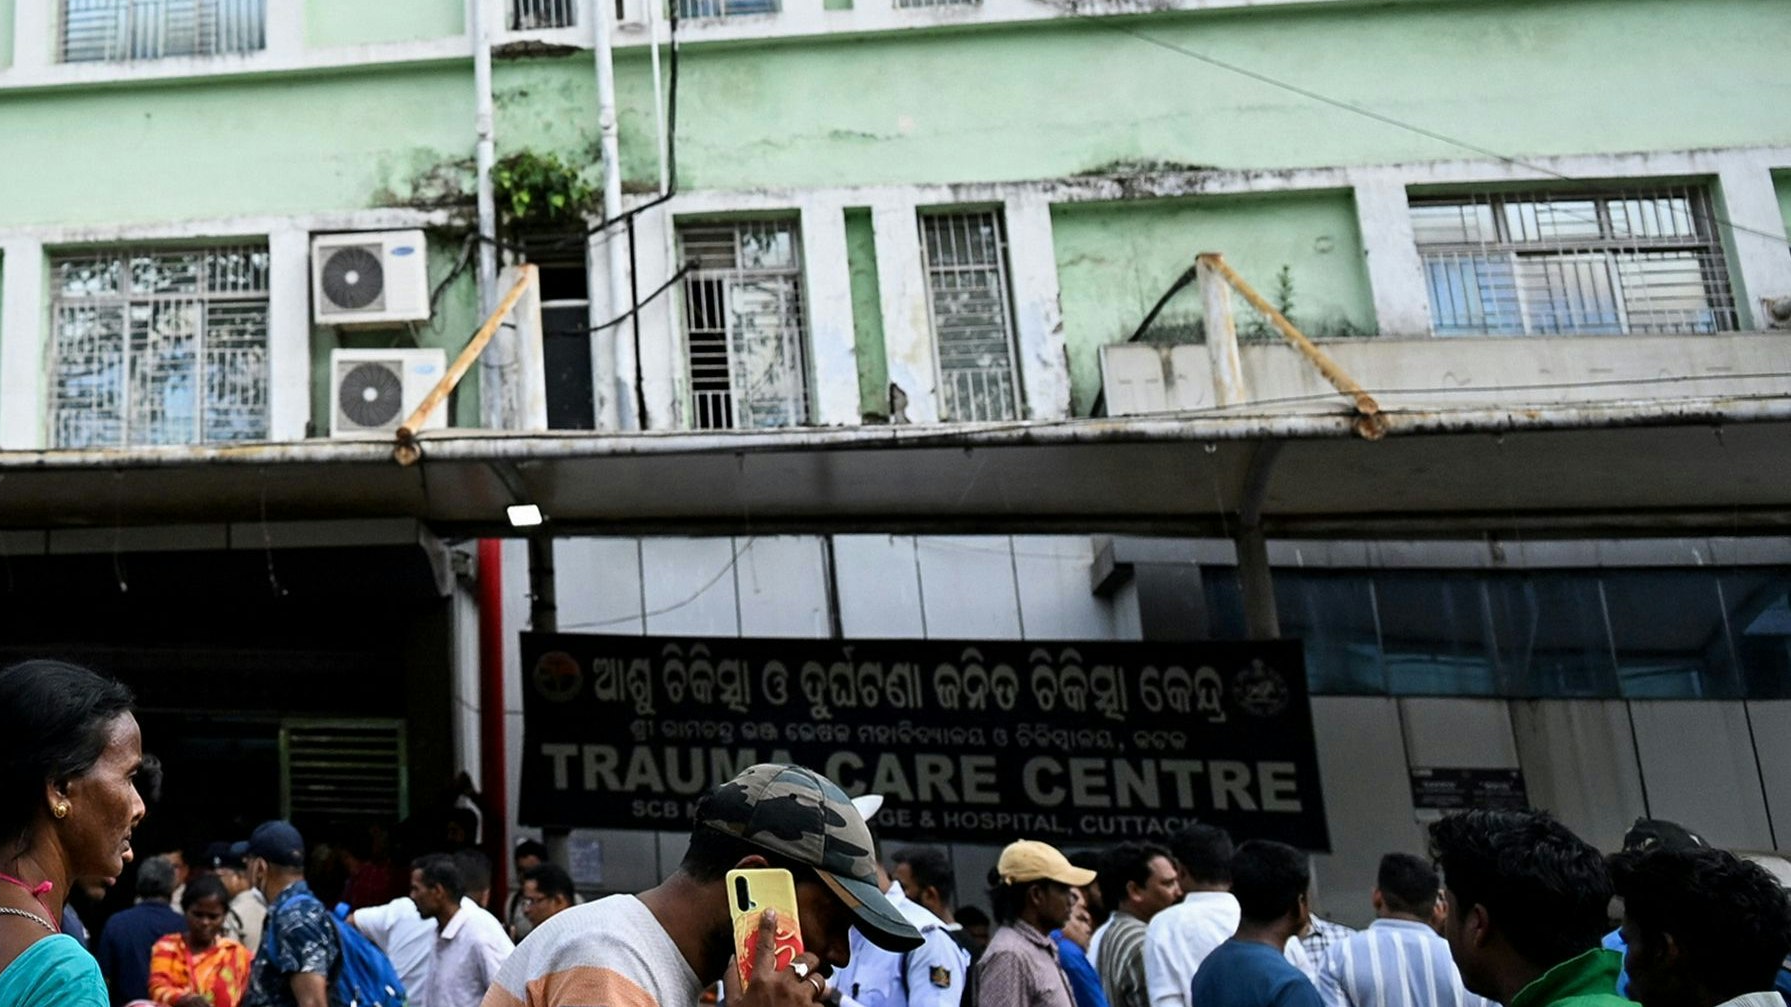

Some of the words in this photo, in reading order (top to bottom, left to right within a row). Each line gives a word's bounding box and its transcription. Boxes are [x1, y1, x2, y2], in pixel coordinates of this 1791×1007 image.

[593, 657, 655, 716] ଆଶୁ
[762, 661, 788, 706] ଓ
[933, 647, 1019, 711] ଜନିତ
[825, 751, 1001, 804] CARE
[1023, 756, 1302, 813] CENTRE
[632, 799, 679, 818] SCB
[943, 811, 1072, 835] HOSPITAL,
